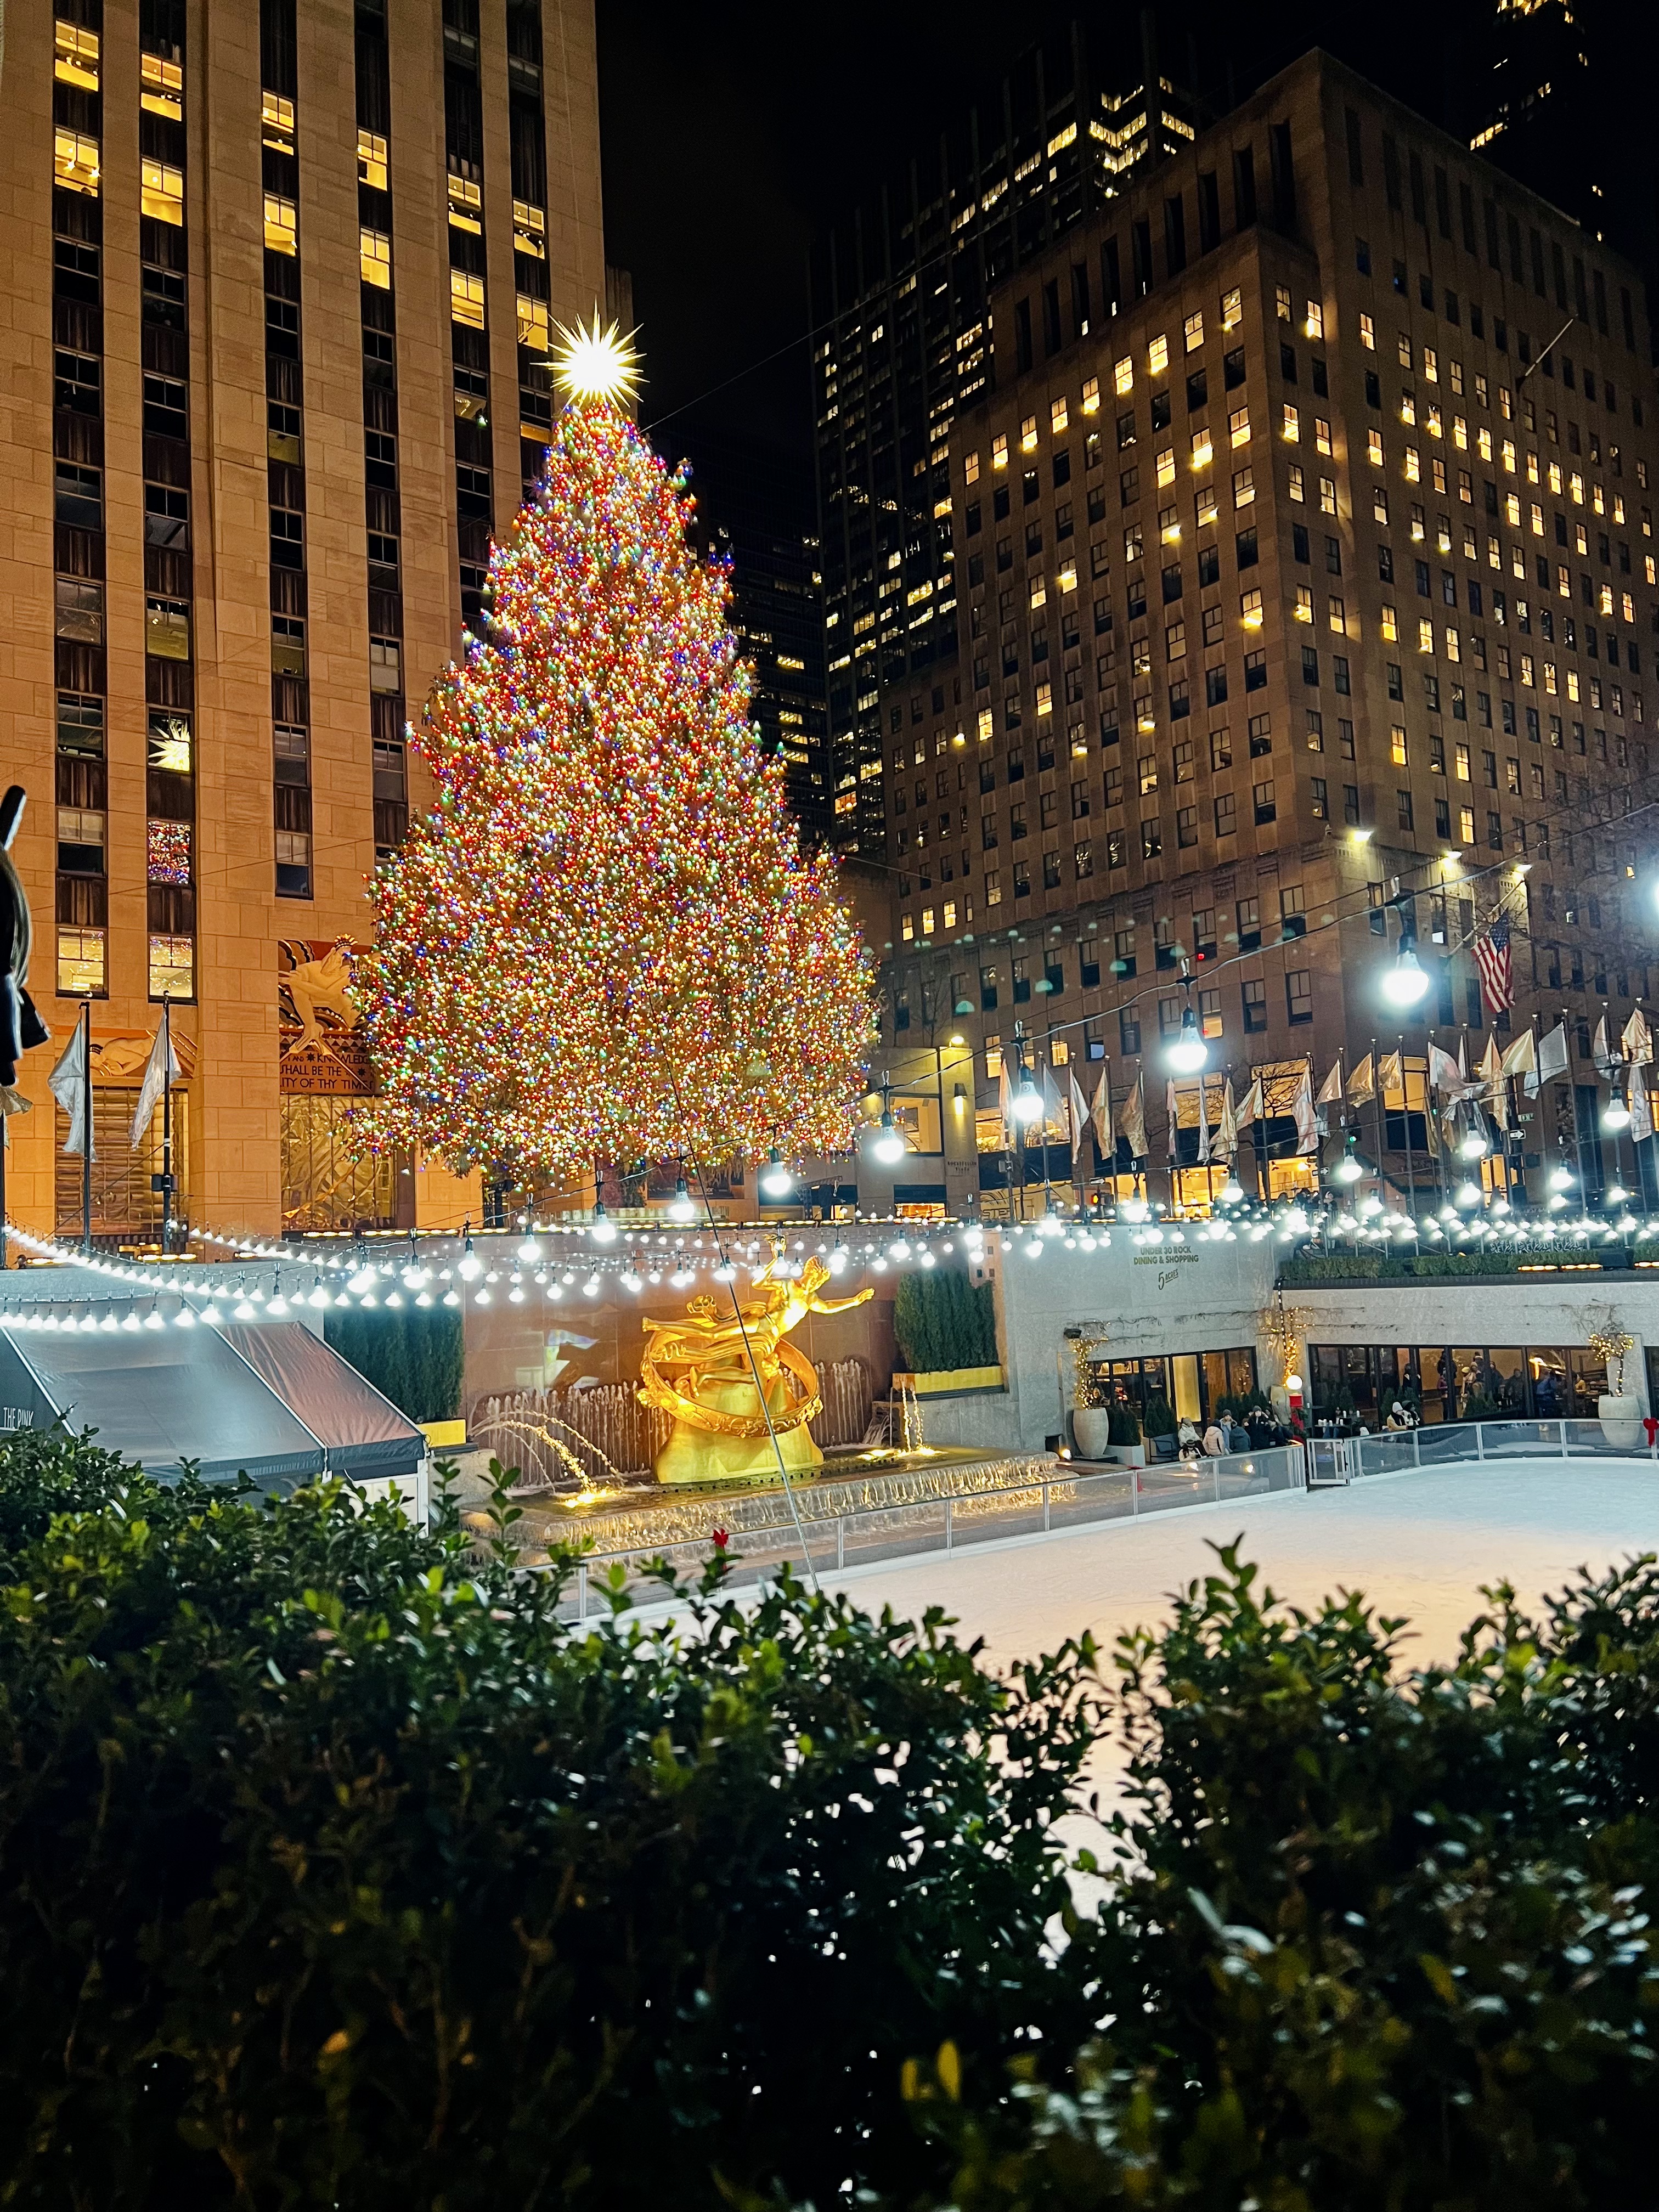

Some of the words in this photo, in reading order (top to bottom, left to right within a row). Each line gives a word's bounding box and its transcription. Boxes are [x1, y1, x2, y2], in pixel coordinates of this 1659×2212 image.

[280, 1064, 309, 1075] SHALL
[312, 1066, 323, 1075] BE
[326, 1066, 341, 1076] THE
[300, 1078, 314, 1088] OF
[317, 1079, 337, 1088] THY
[1140, 1246, 1163, 1255] UNDER
[1133, 1256, 1158, 1265] DINING
[1159, 1256, 1164, 1264] &
[1166, 1255, 1199, 1263] SHOPPING
[1158, 1271, 1164, 1290] 5
[1165, 1269, 1178, 1280] ACRES
[3, 1407, 15, 1429] THE
